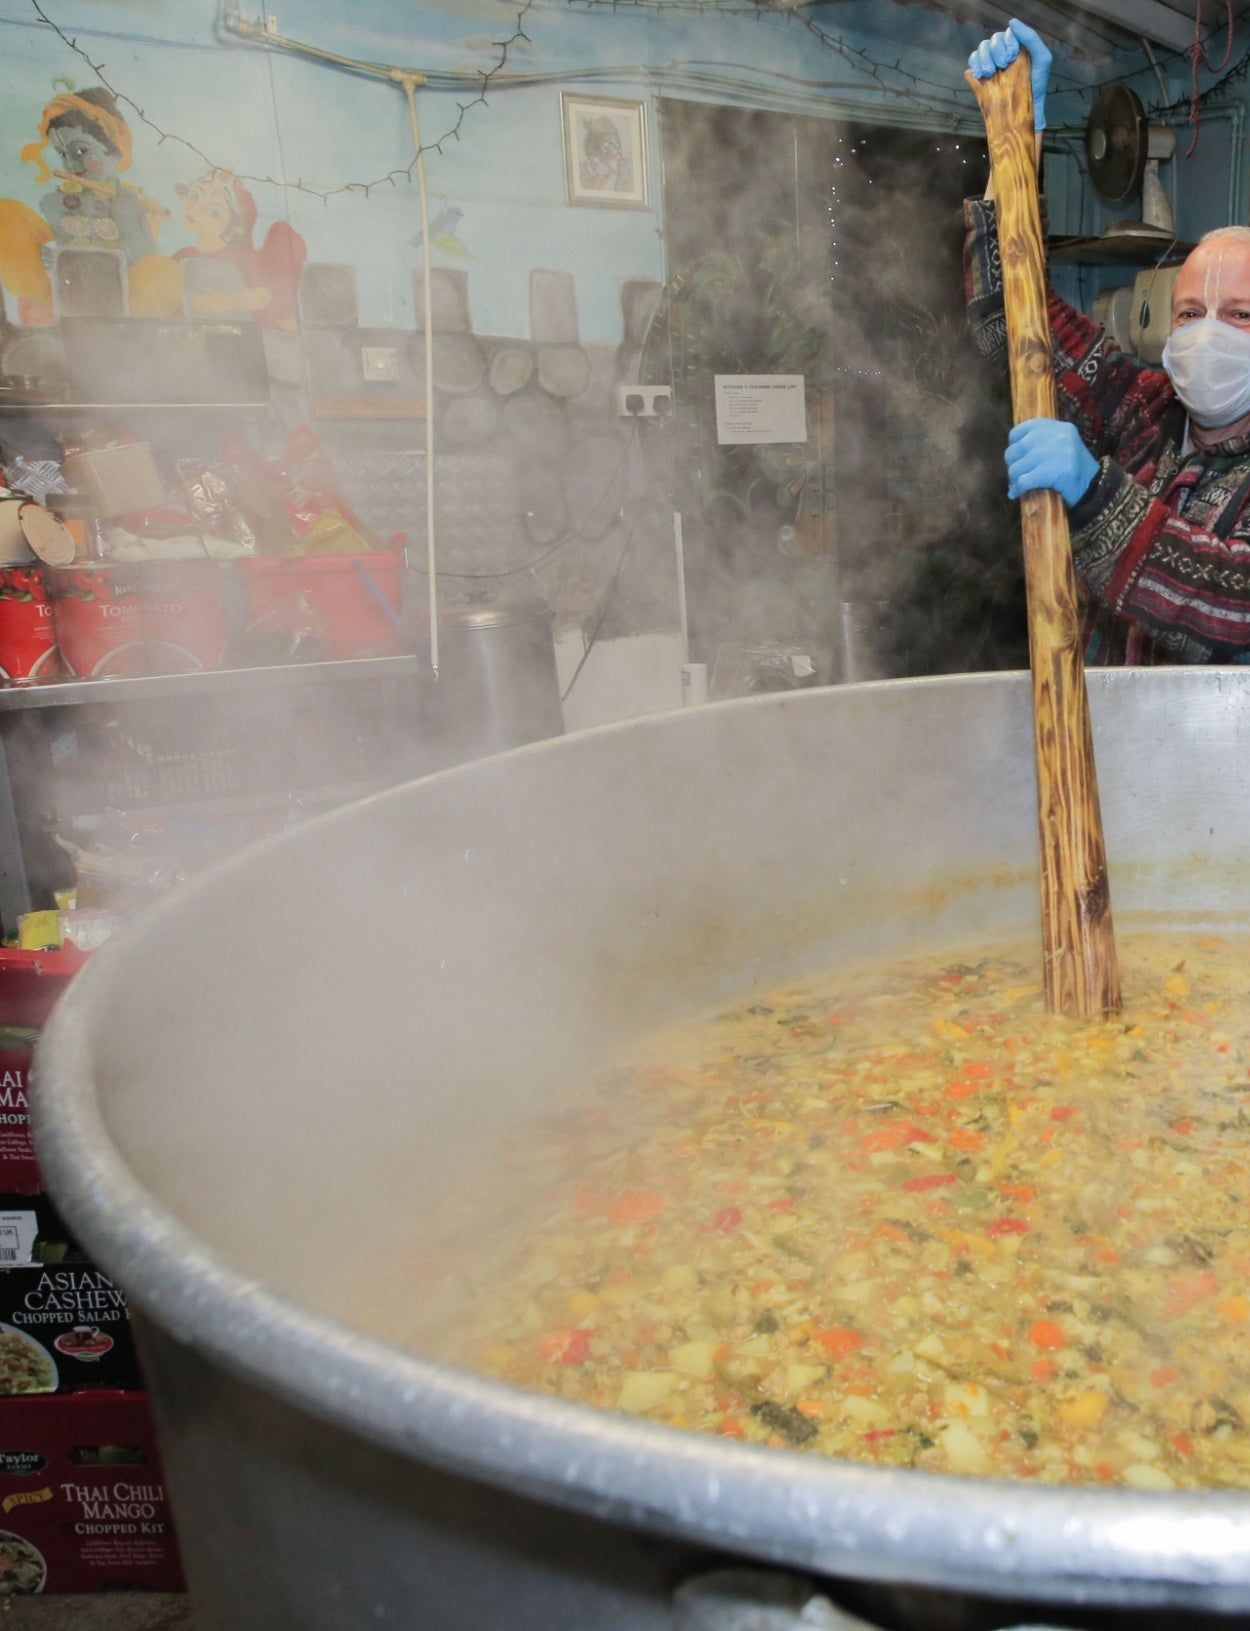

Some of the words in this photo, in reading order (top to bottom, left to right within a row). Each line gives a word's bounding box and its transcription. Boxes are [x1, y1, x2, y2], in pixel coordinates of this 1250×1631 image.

[37, 1272, 113, 1291] ASIAN
[24, 1290, 128, 1311] CASHEW
[12, 1311, 73, 1324] CHOPPED
[78, 1309, 120, 1323] SALAD
[0, 1453, 39, 1464] Taylor
[60, 1484, 109, 1502] THAI
[113, 1482, 164, 1501] CHILI
[82, 1501, 155, 1519] MANGO
[74, 1523, 137, 1534] CHOPPED
[141, 1522, 165, 1533] KIT
